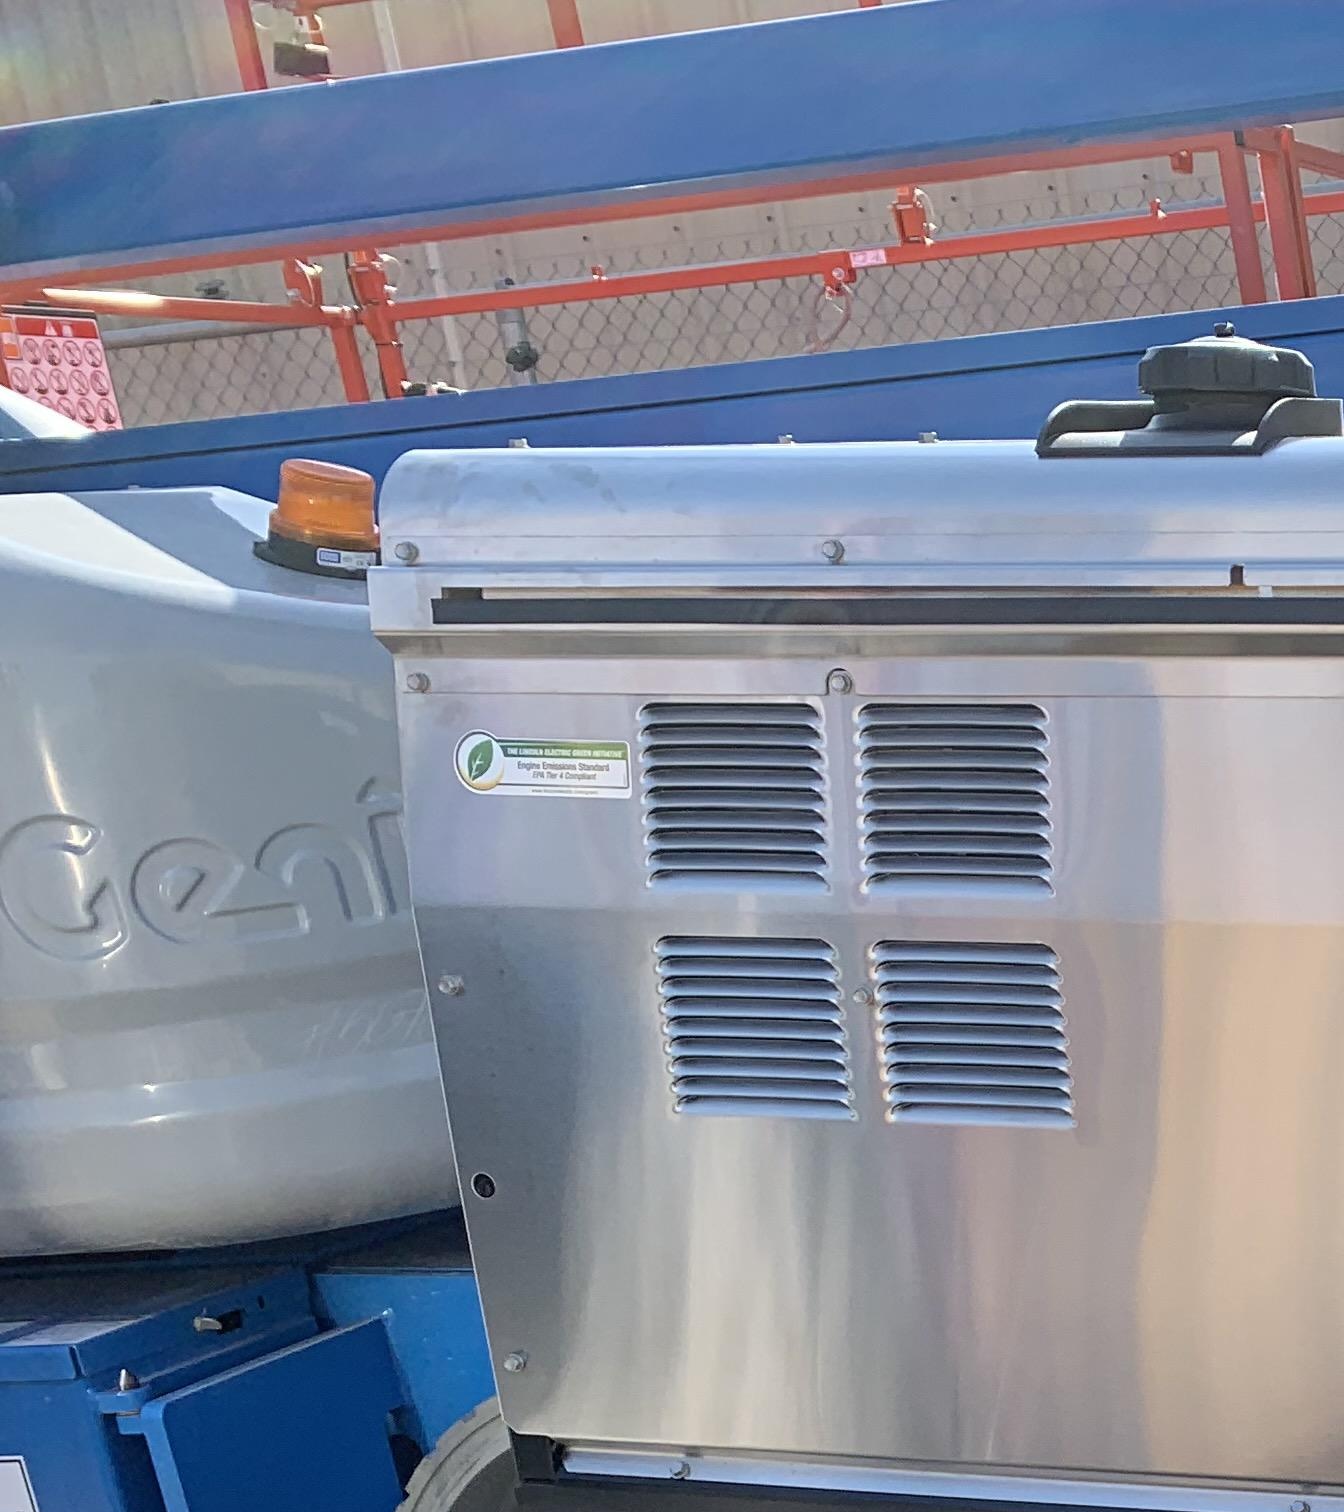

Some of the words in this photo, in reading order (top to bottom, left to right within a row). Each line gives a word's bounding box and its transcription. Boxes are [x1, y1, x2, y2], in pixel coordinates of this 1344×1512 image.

[517, 761, 540, 771] Engine
[542, 762, 576, 771] Emissions
[578, 763, 610, 772] Standard
[565, 772, 597, 782] Compliant
